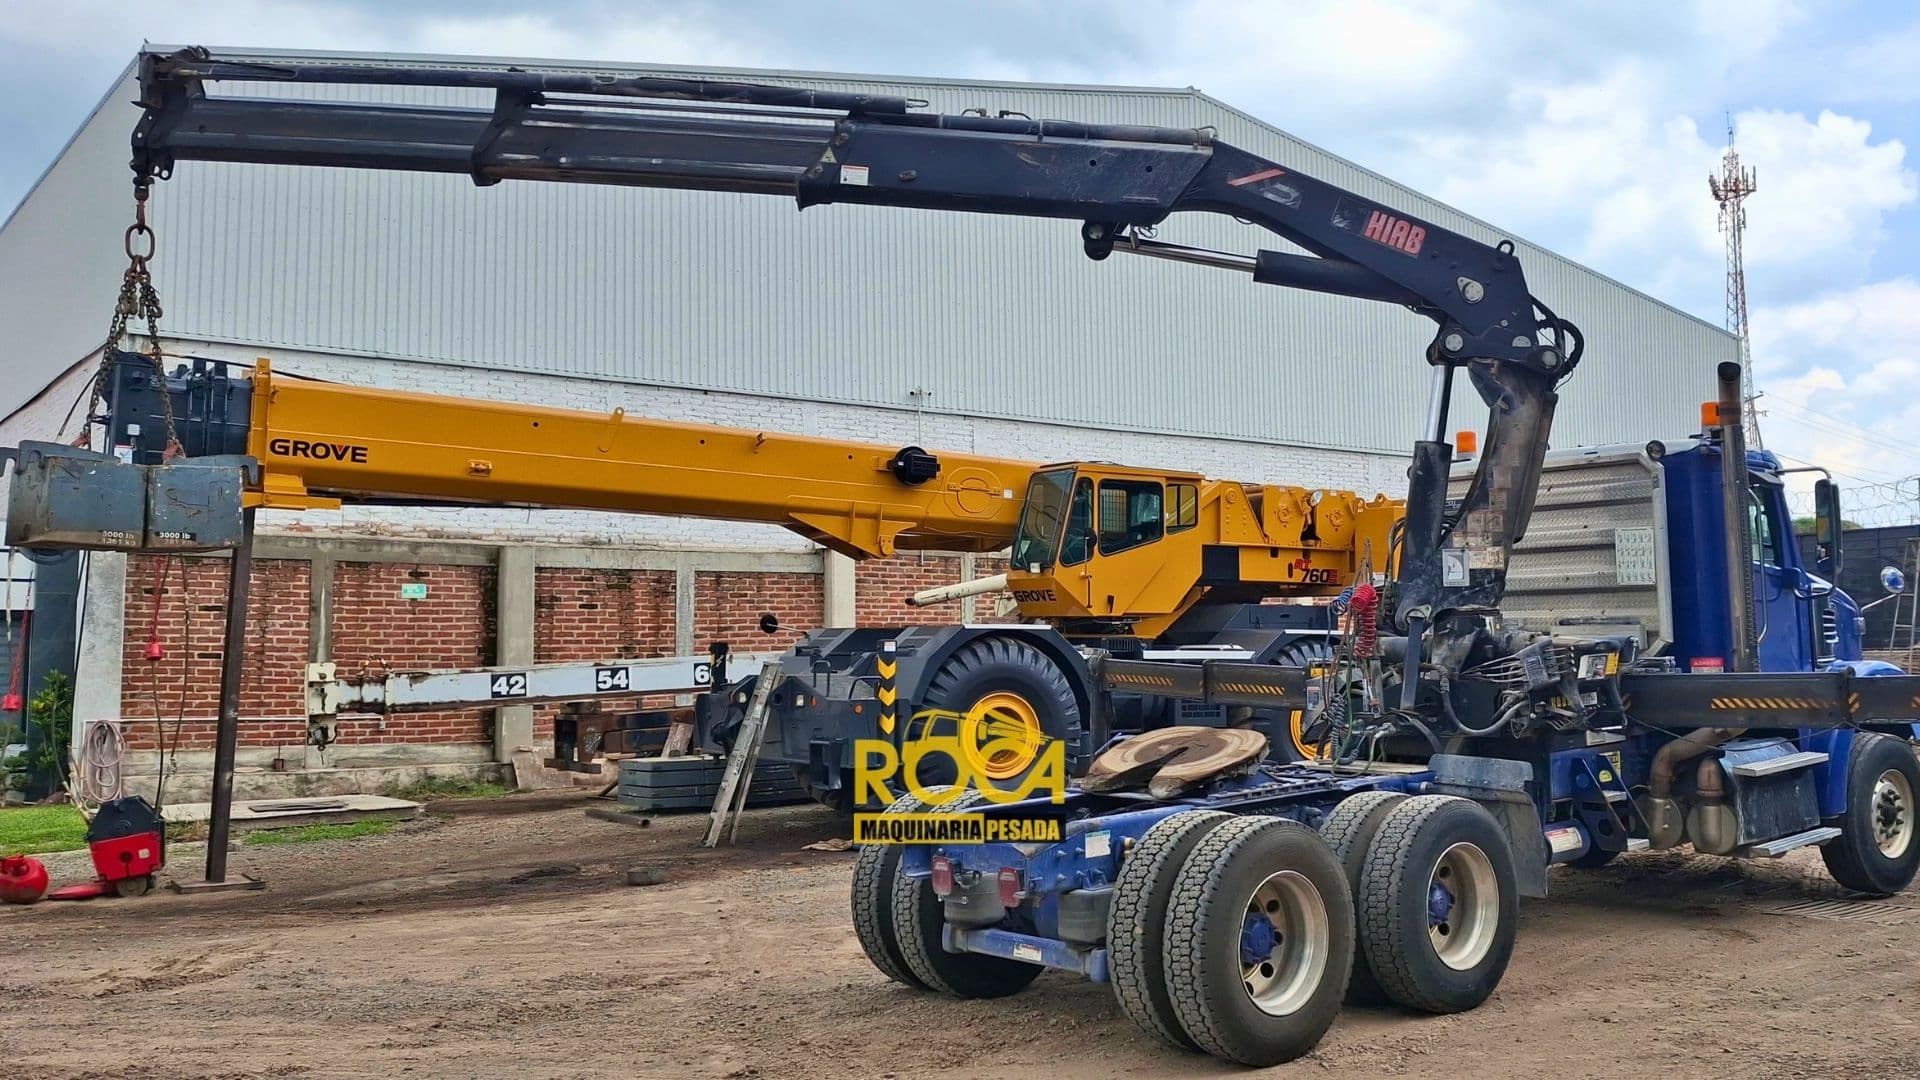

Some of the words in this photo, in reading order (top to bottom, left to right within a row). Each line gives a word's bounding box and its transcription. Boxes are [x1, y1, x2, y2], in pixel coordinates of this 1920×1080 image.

[1364, 210, 1426, 254] HIAB
[269, 438, 368, 463] GROVE
[182, 532, 191, 540] lb
[1294, 558, 1311, 570] RT
[1013, 589, 1057, 603] GROVE
[597, 669, 629, 690] 54
[694, 665, 711, 684] 6
[492, 675, 526, 696] 42
